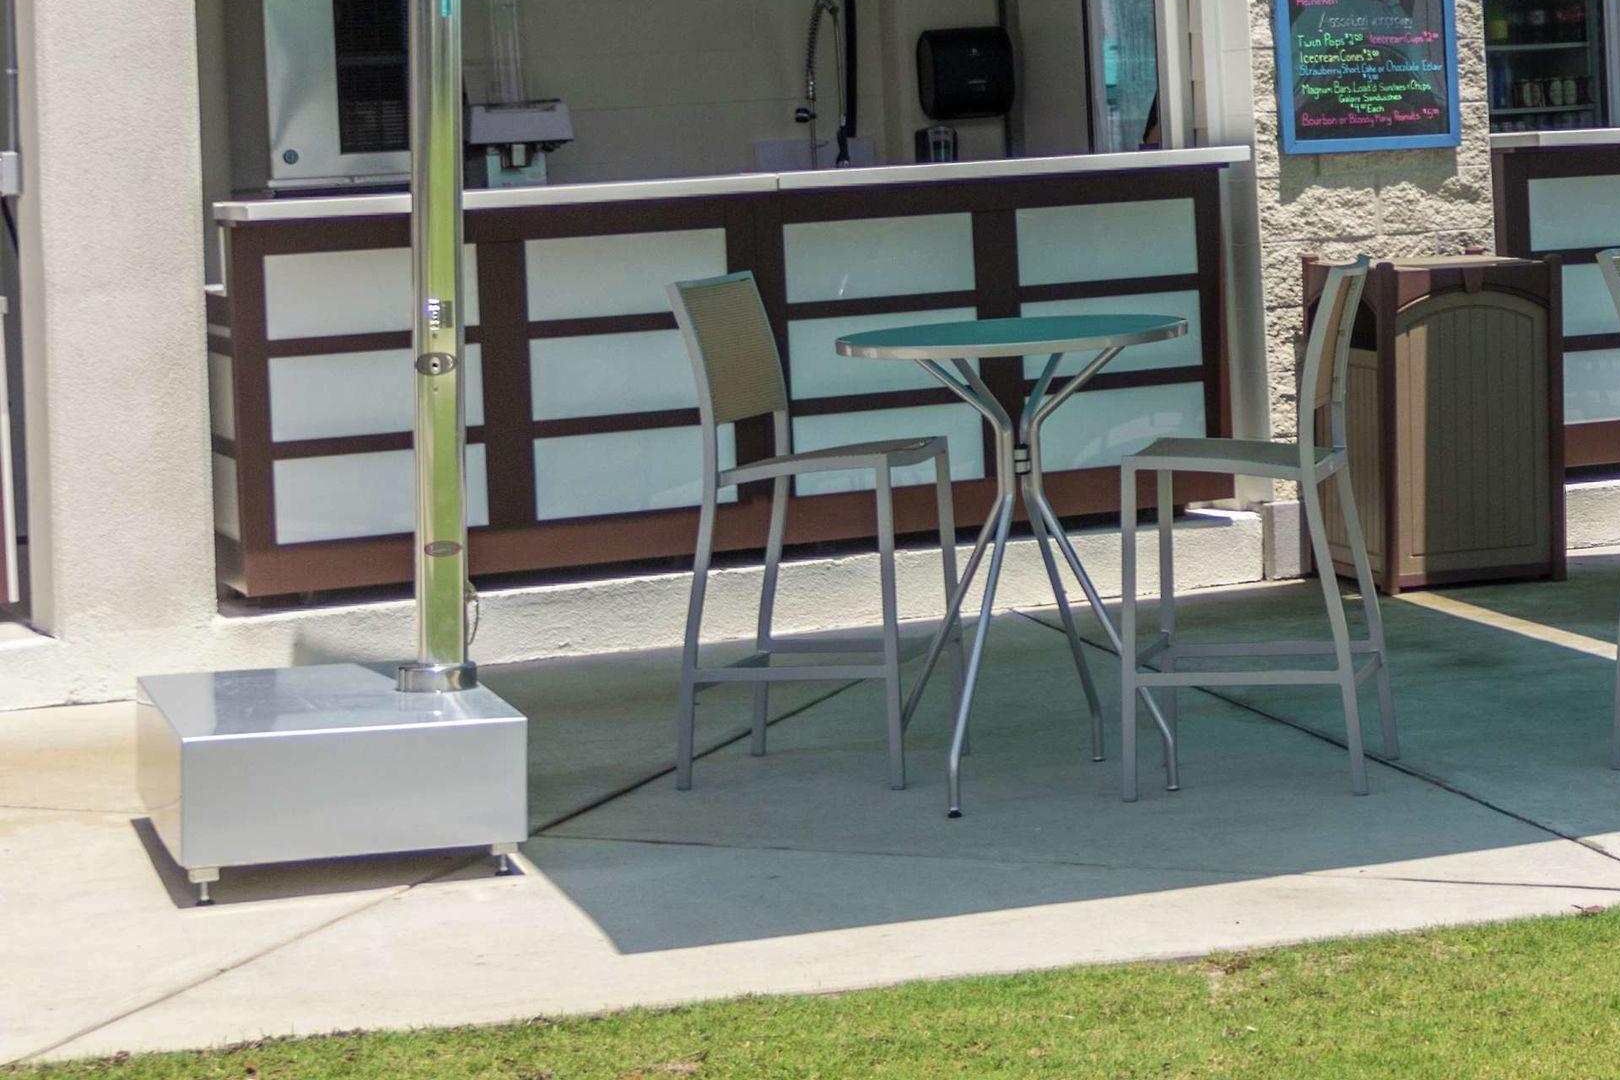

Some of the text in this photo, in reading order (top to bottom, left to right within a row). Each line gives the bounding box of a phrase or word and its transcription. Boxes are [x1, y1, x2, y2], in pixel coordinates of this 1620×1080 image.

[1297, 34, 1321, 47] Twin
[1323, 32, 1345, 48] Pops
[1340, 49, 1364, 61] Cones
[1386, 60, 1419, 72] Chocolate
[1363, 92, 1402, 102] Sandwiches
[1367, 103, 1384, 113] Each
[1302, 111, 1338, 126] Bourbon
